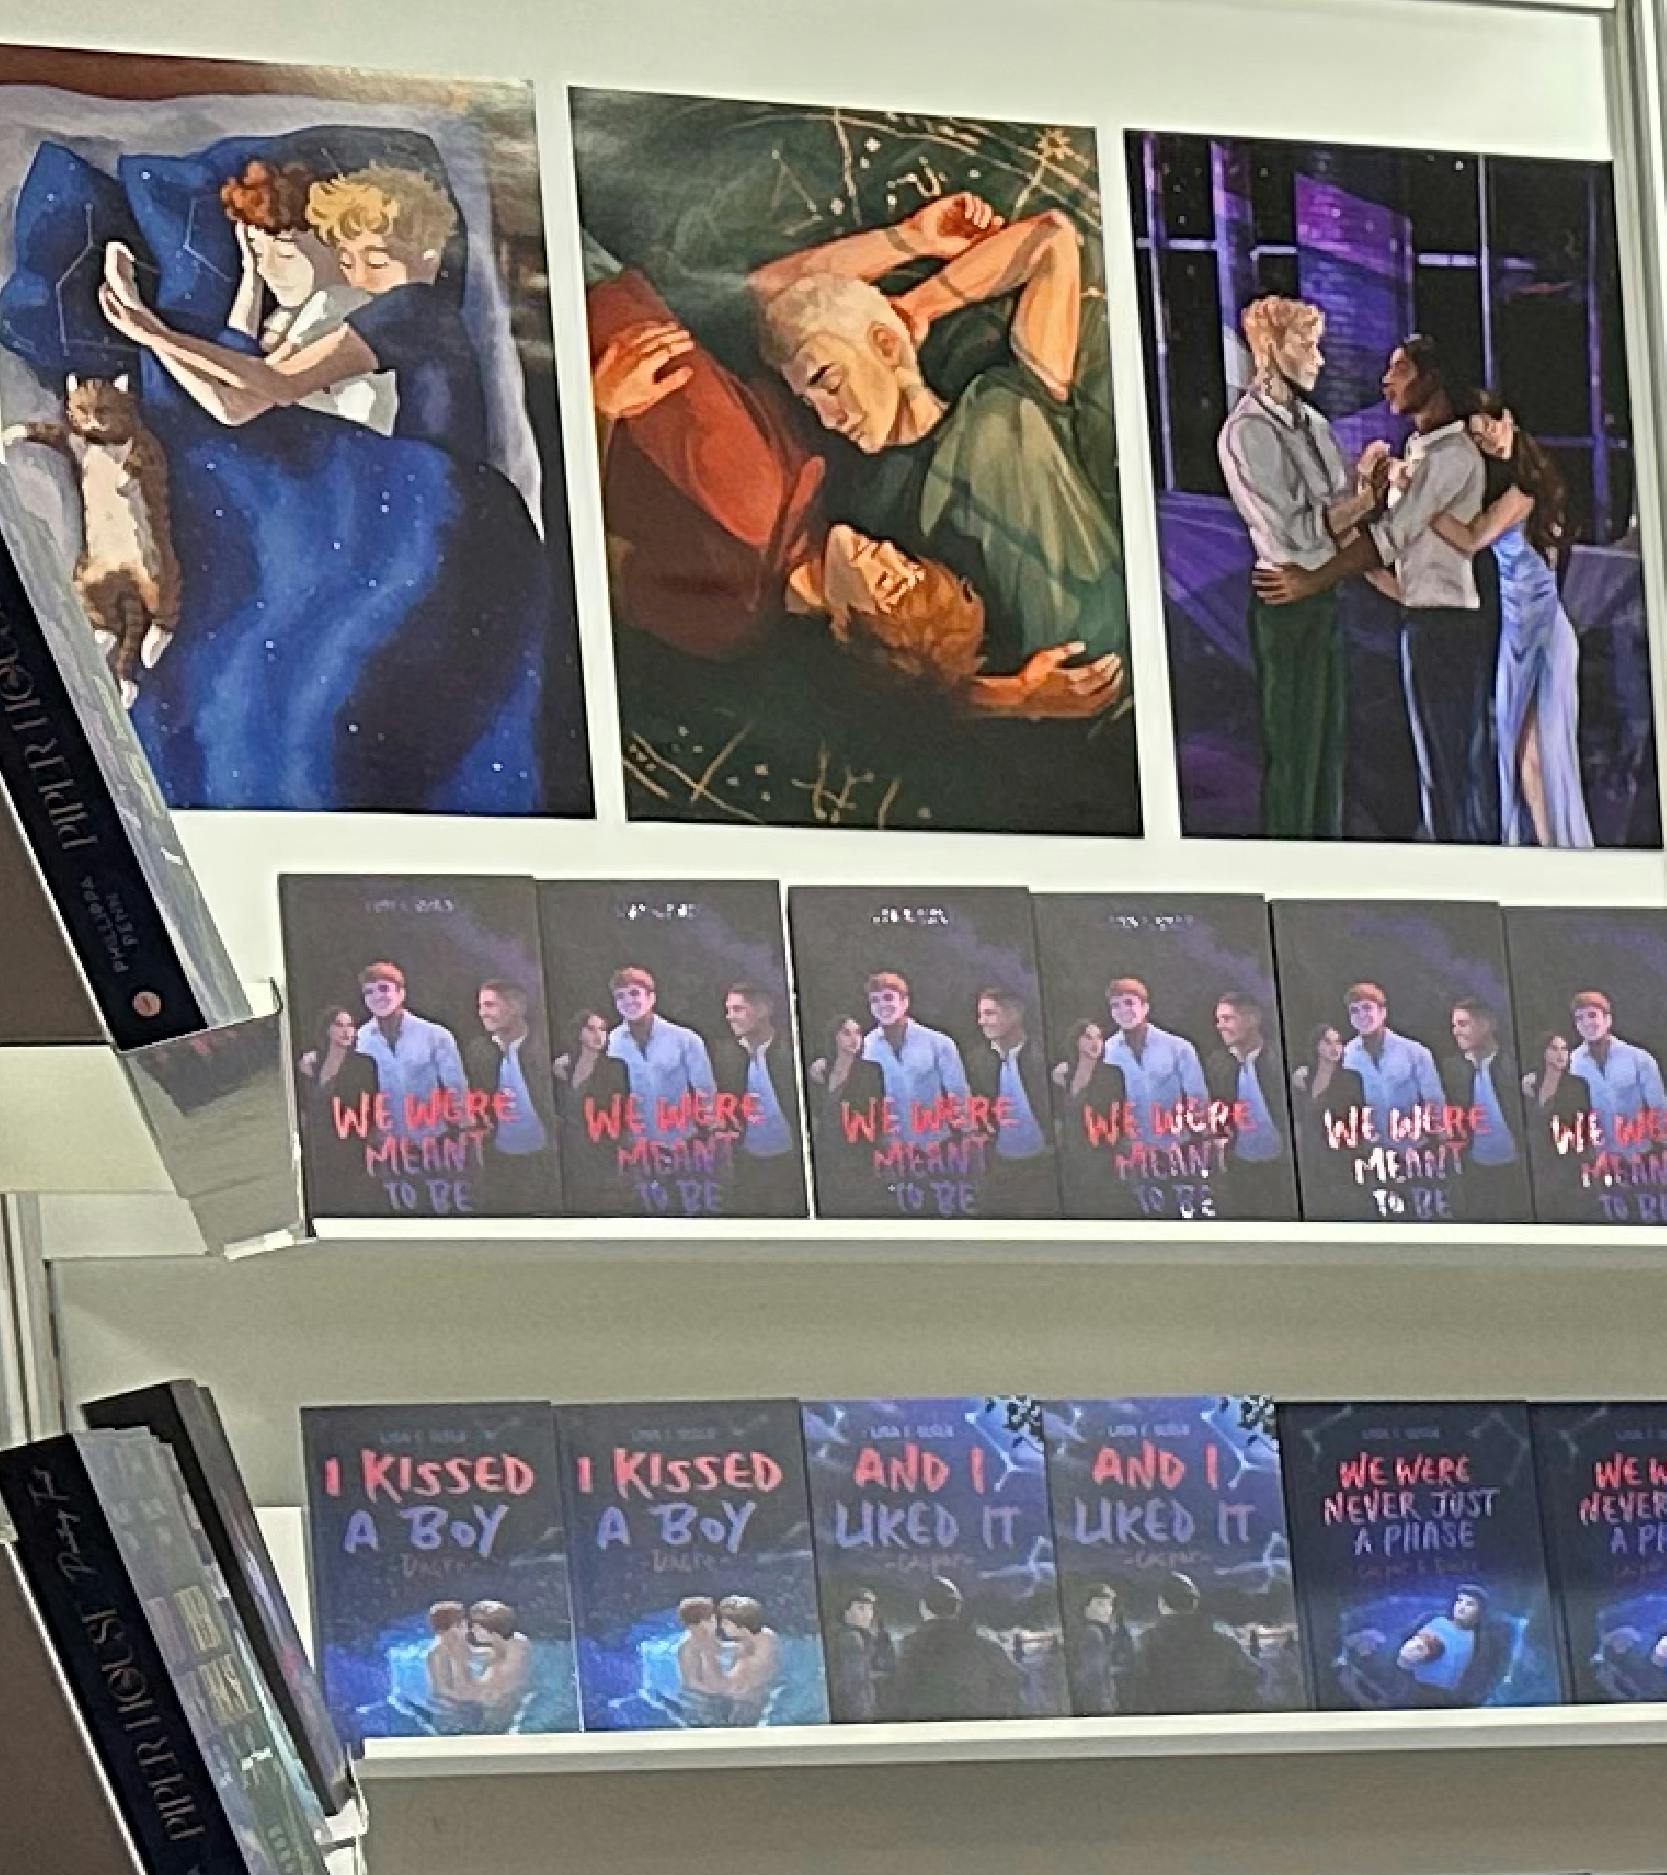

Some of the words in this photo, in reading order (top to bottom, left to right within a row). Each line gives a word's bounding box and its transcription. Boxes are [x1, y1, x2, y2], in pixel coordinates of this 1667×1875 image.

[332, 1093, 395, 1141] WE
[404, 1088, 518, 1129] WERE
[365, 1129, 486, 1179] MEANT
[324, 1457, 340, 1496] I
[361, 1449, 534, 1503] KISSED
[855, 1445, 950, 1494] AND
[970, 1446, 986, 1496] I
[1338, 1452, 1388, 1488] WE
[1395, 1452, 1471, 1486] WERE
[835, 1503, 960, 1549] LIKED
[982, 1504, 1022, 1549] IT
[1322, 1491, 1417, 1527] NEVER
[1431, 1488, 1498, 1520] JUST
[343, 1510, 379, 1553] A
[1353, 1527, 1373, 1557] A
[1383, 1521, 1477, 1554] PHASE
